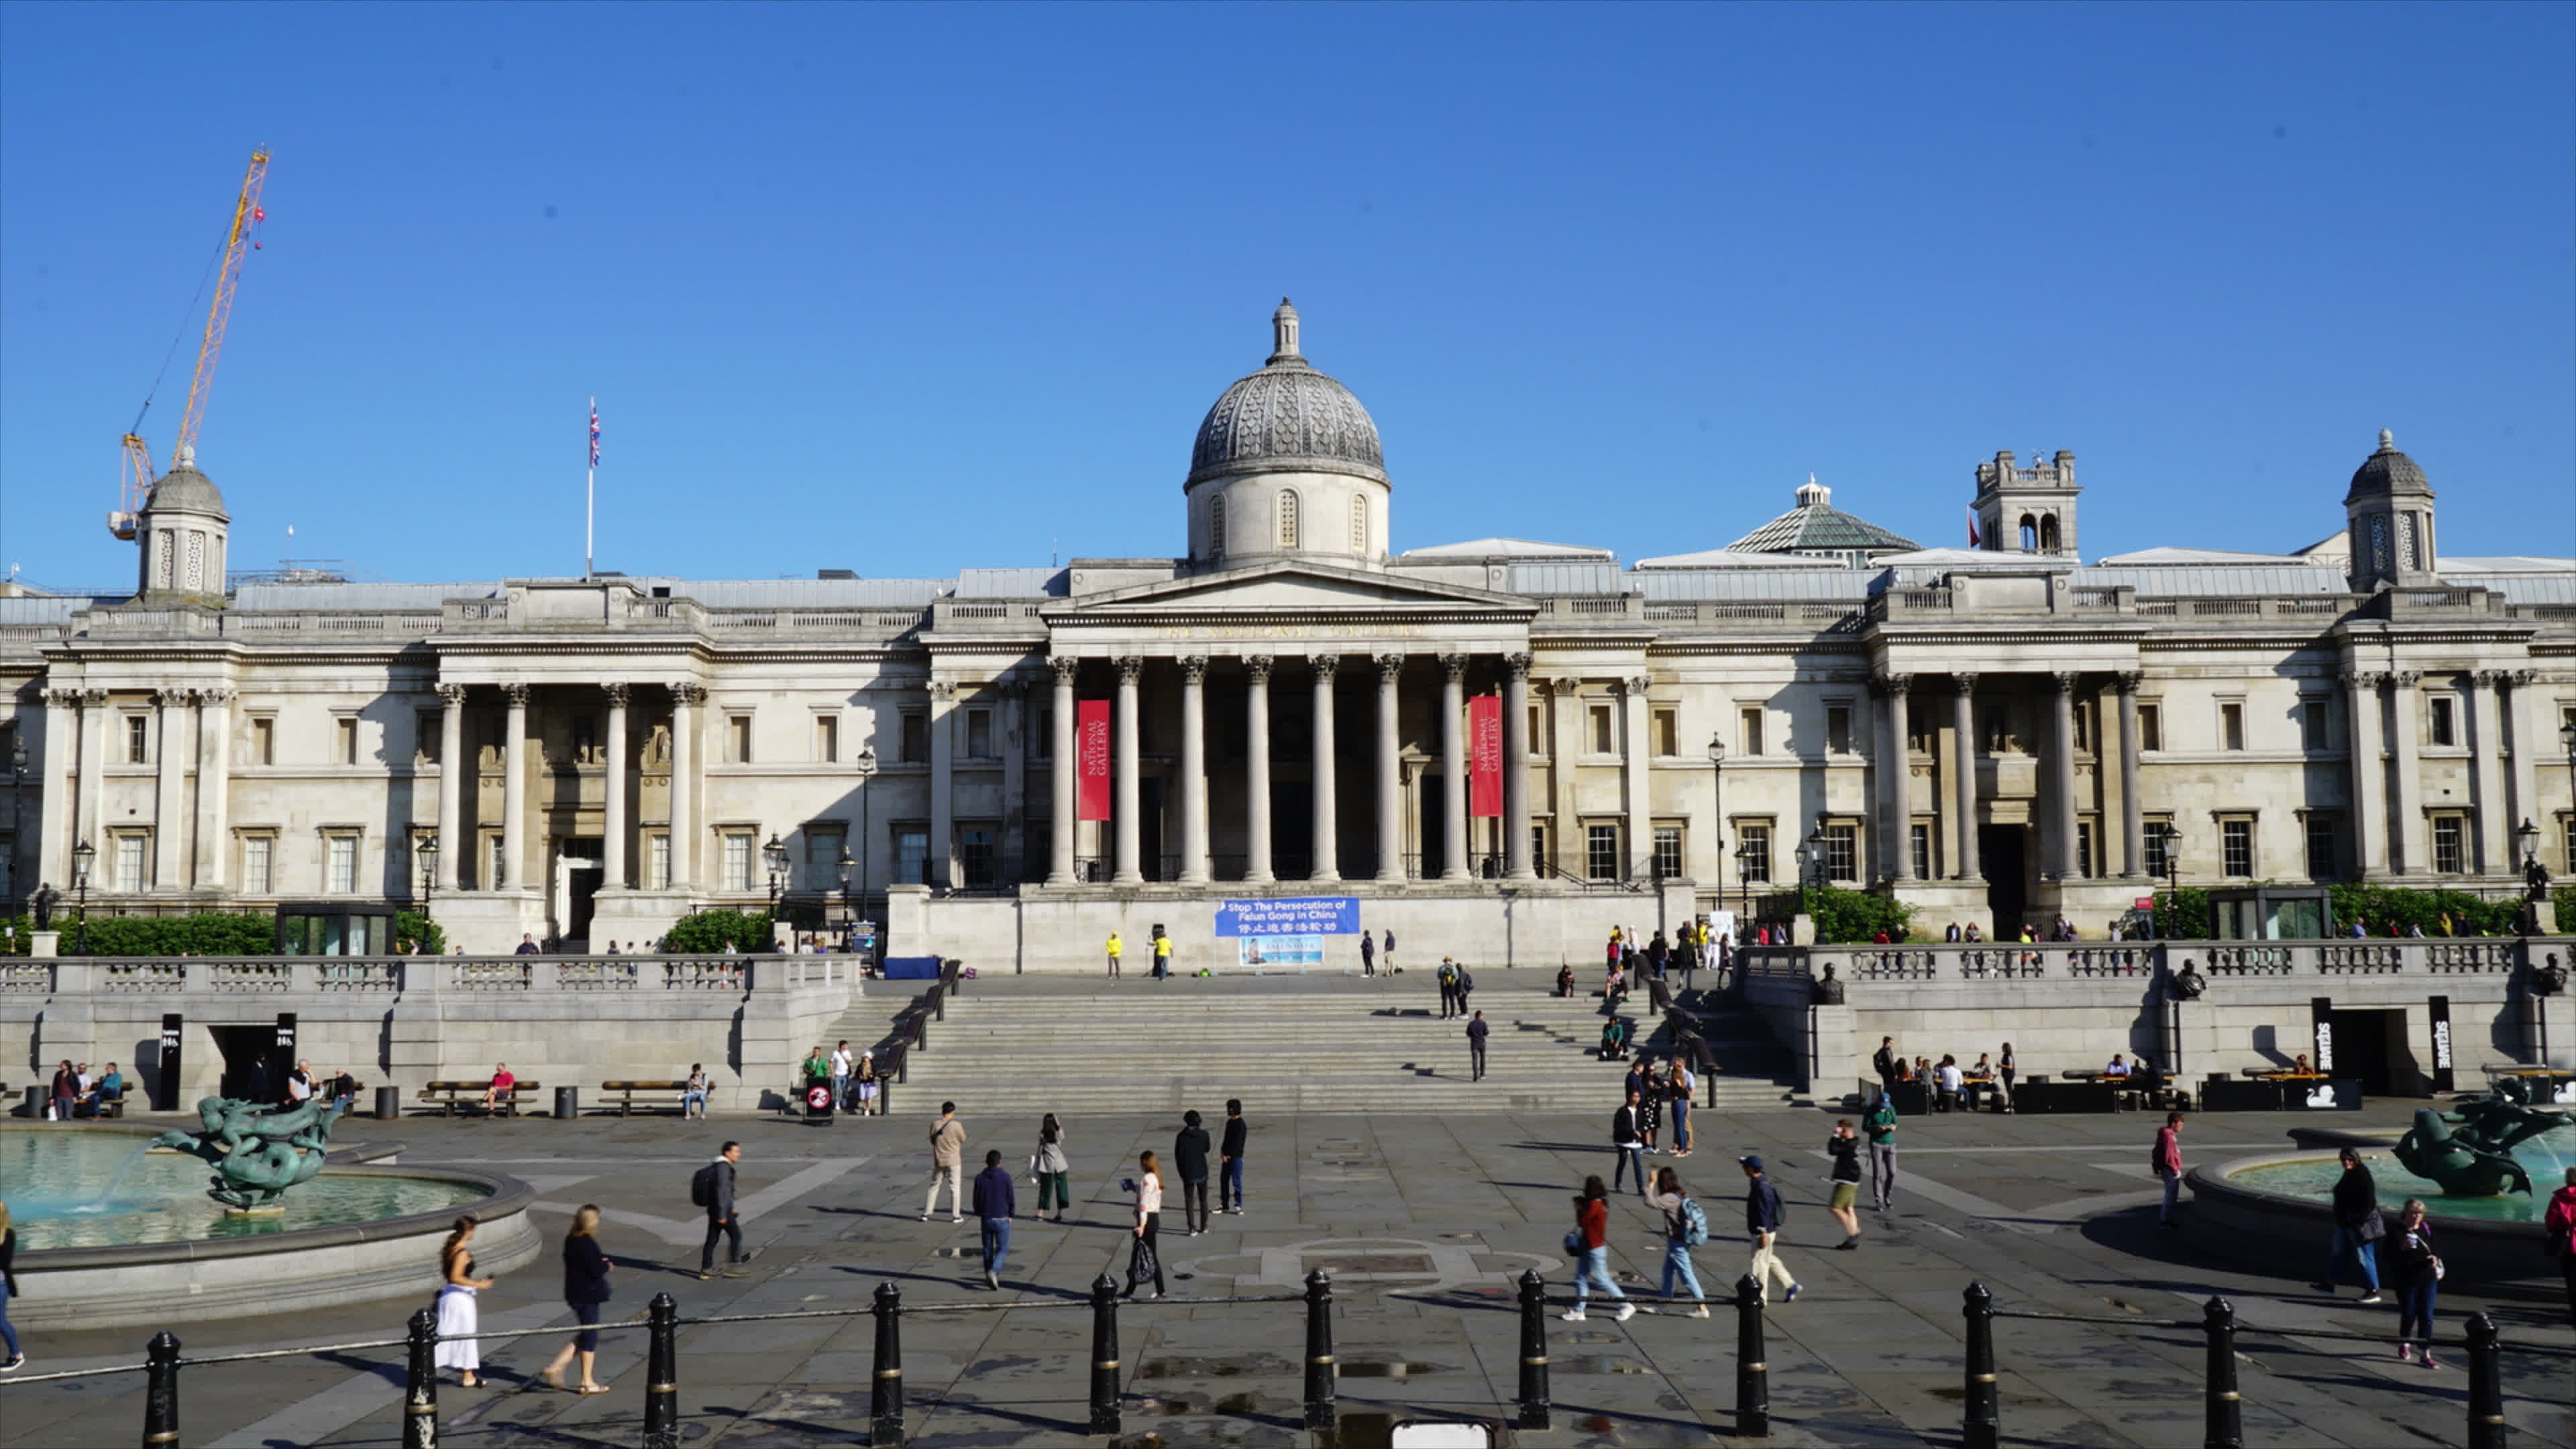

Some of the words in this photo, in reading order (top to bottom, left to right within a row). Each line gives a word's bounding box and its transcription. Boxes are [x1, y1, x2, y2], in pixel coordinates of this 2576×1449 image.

[1088, 722, 1096, 775] NATIONAL
[1097, 720, 1106, 776] GALLERY
[1489, 717, 1498, 772] GALLERY
[1228, 903, 1251, 912] Stop
[1253, 902, 1273, 911] The
[1275, 901, 1333, 910] Persecution
[1336, 900, 1346, 909] of
[1238, 912, 1266, 921] Falun
[1268, 911, 1295, 921] Gong
[1297, 910, 1307, 919] in
[1309, 910, 1337, 919] China
[2316, 1022, 2332, 1071] SQUARE
[2434, 1020, 2451, 1069] SQUARE
